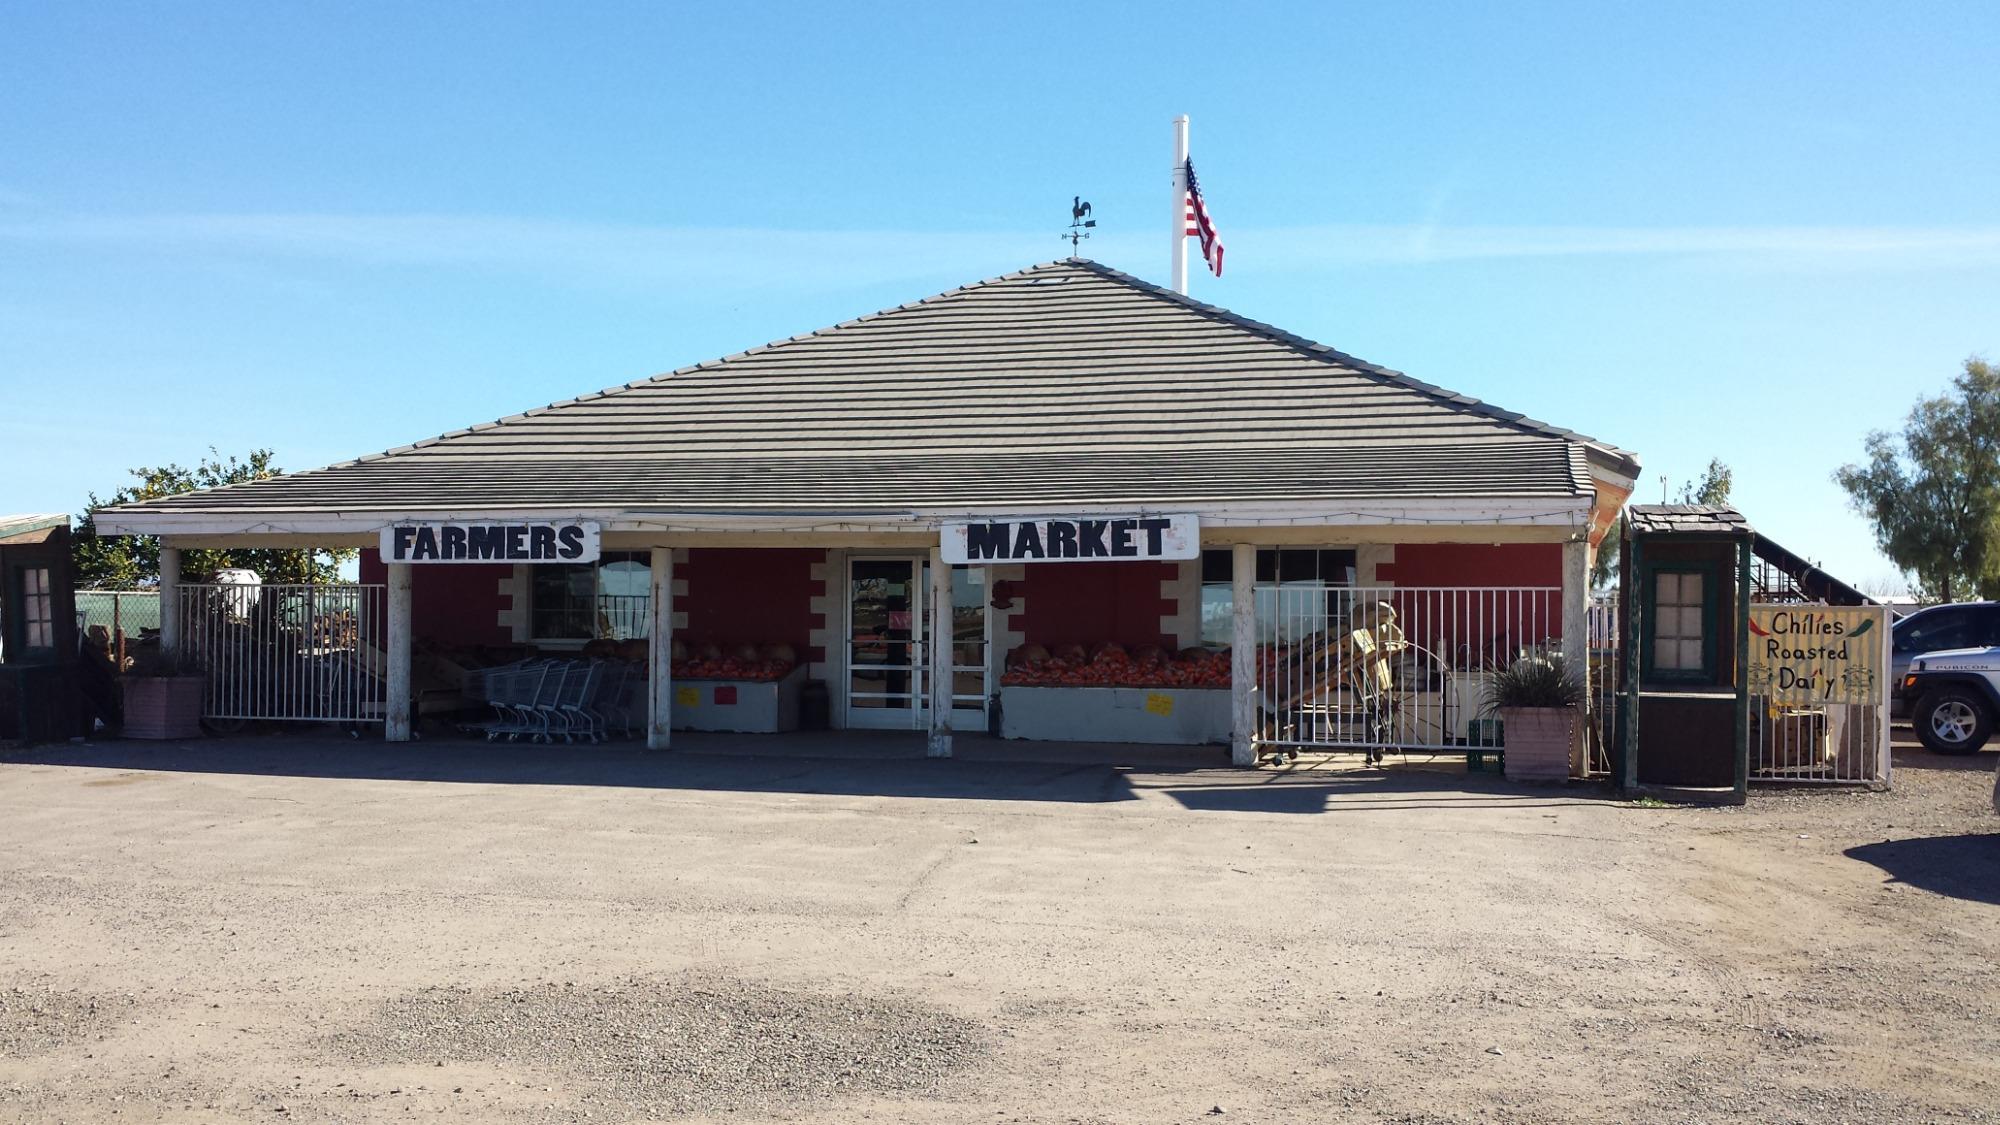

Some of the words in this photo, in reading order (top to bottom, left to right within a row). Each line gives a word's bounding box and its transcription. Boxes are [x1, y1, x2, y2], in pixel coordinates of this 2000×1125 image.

[394, 525, 585, 560] FARMERS
[967, 519, 1170, 559] MARKET
[1772, 612, 1844, 635] Chilies
[1766, 639, 1848, 660] Roasted
